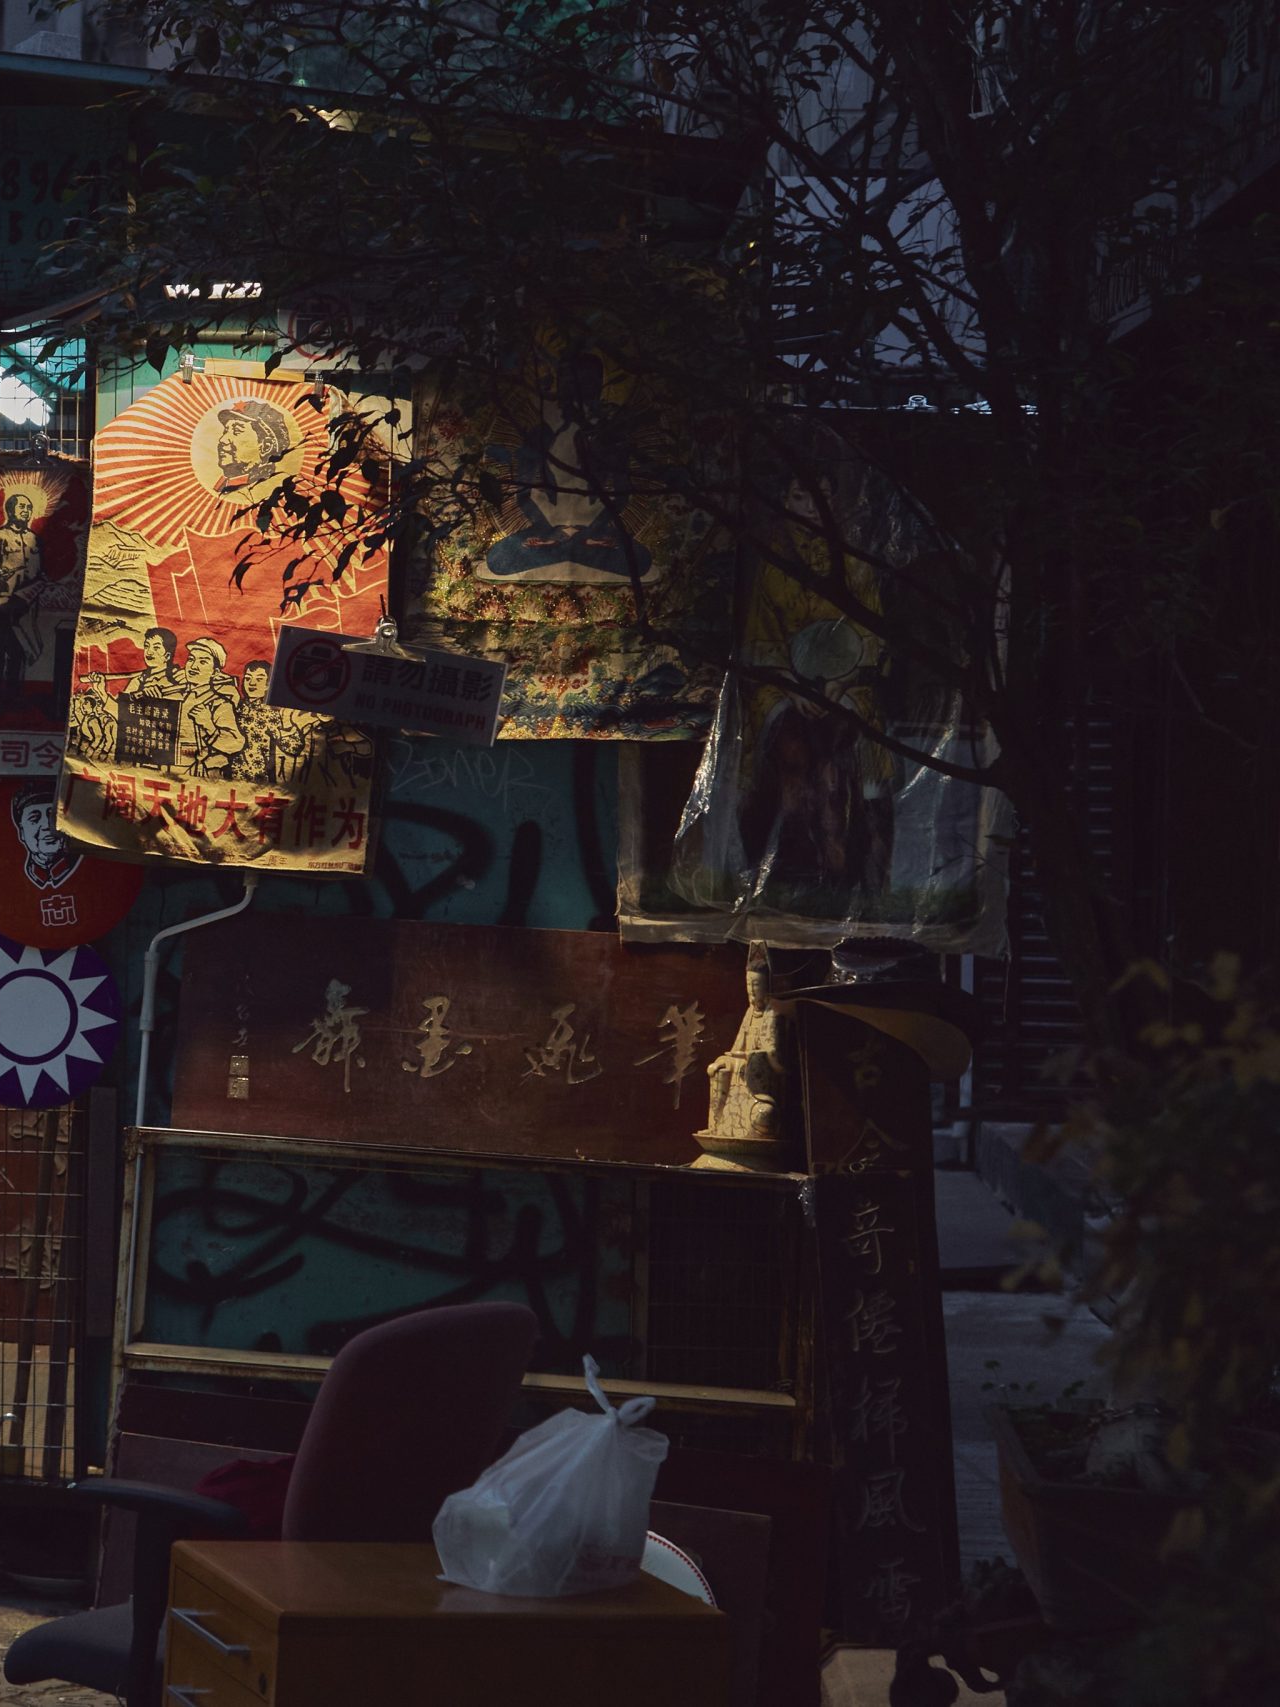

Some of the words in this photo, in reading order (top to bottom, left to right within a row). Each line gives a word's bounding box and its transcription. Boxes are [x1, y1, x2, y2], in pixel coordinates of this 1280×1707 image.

[360, 654, 494, 703] 請勿攝影
[354, 692, 376, 710] NO
[382, 699, 487, 730] PHOTOGRAPH
[63, 769, 366, 851] 广阔天地大有作为
